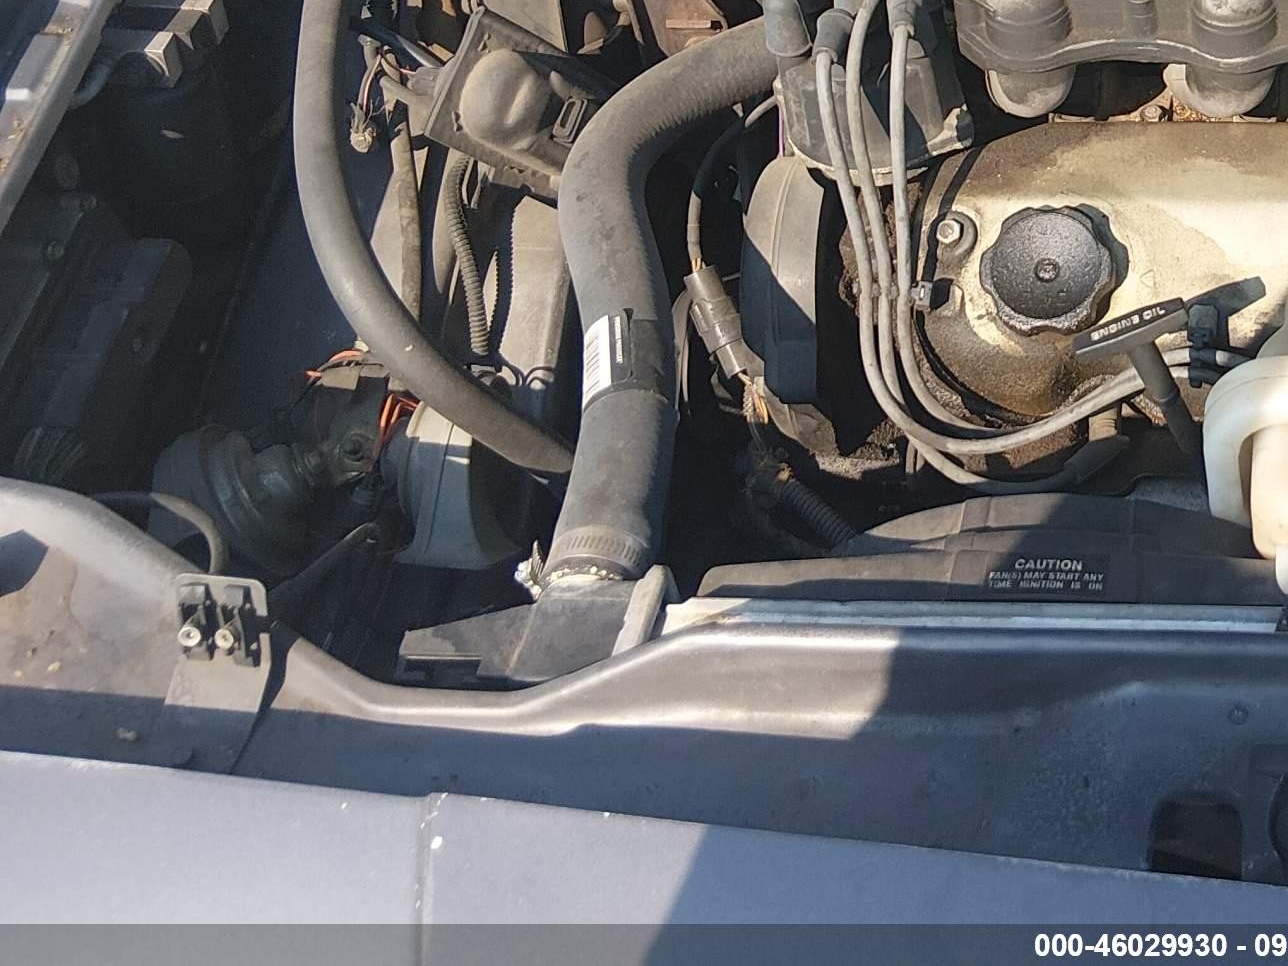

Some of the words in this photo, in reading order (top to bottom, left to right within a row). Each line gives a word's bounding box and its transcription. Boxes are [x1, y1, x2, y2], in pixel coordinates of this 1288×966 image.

[1090, 314, 1140, 341] ENGINE
[1142, 306, 1166, 321] OIL
[1014, 558, 1083, 571] CAUTION
[989, 571, 1021, 580] FAN(S)
[1023, 571, 1046, 580] MAY
[1048, 571, 1080, 581] START
[1083, 573, 1104, 581] ANY
[989, 580, 1012, 588] TIME
[1020, 580, 1064, 589] IGNITION
[1070, 581, 1081, 589] IS
[1088, 582, 1103, 590] ON
